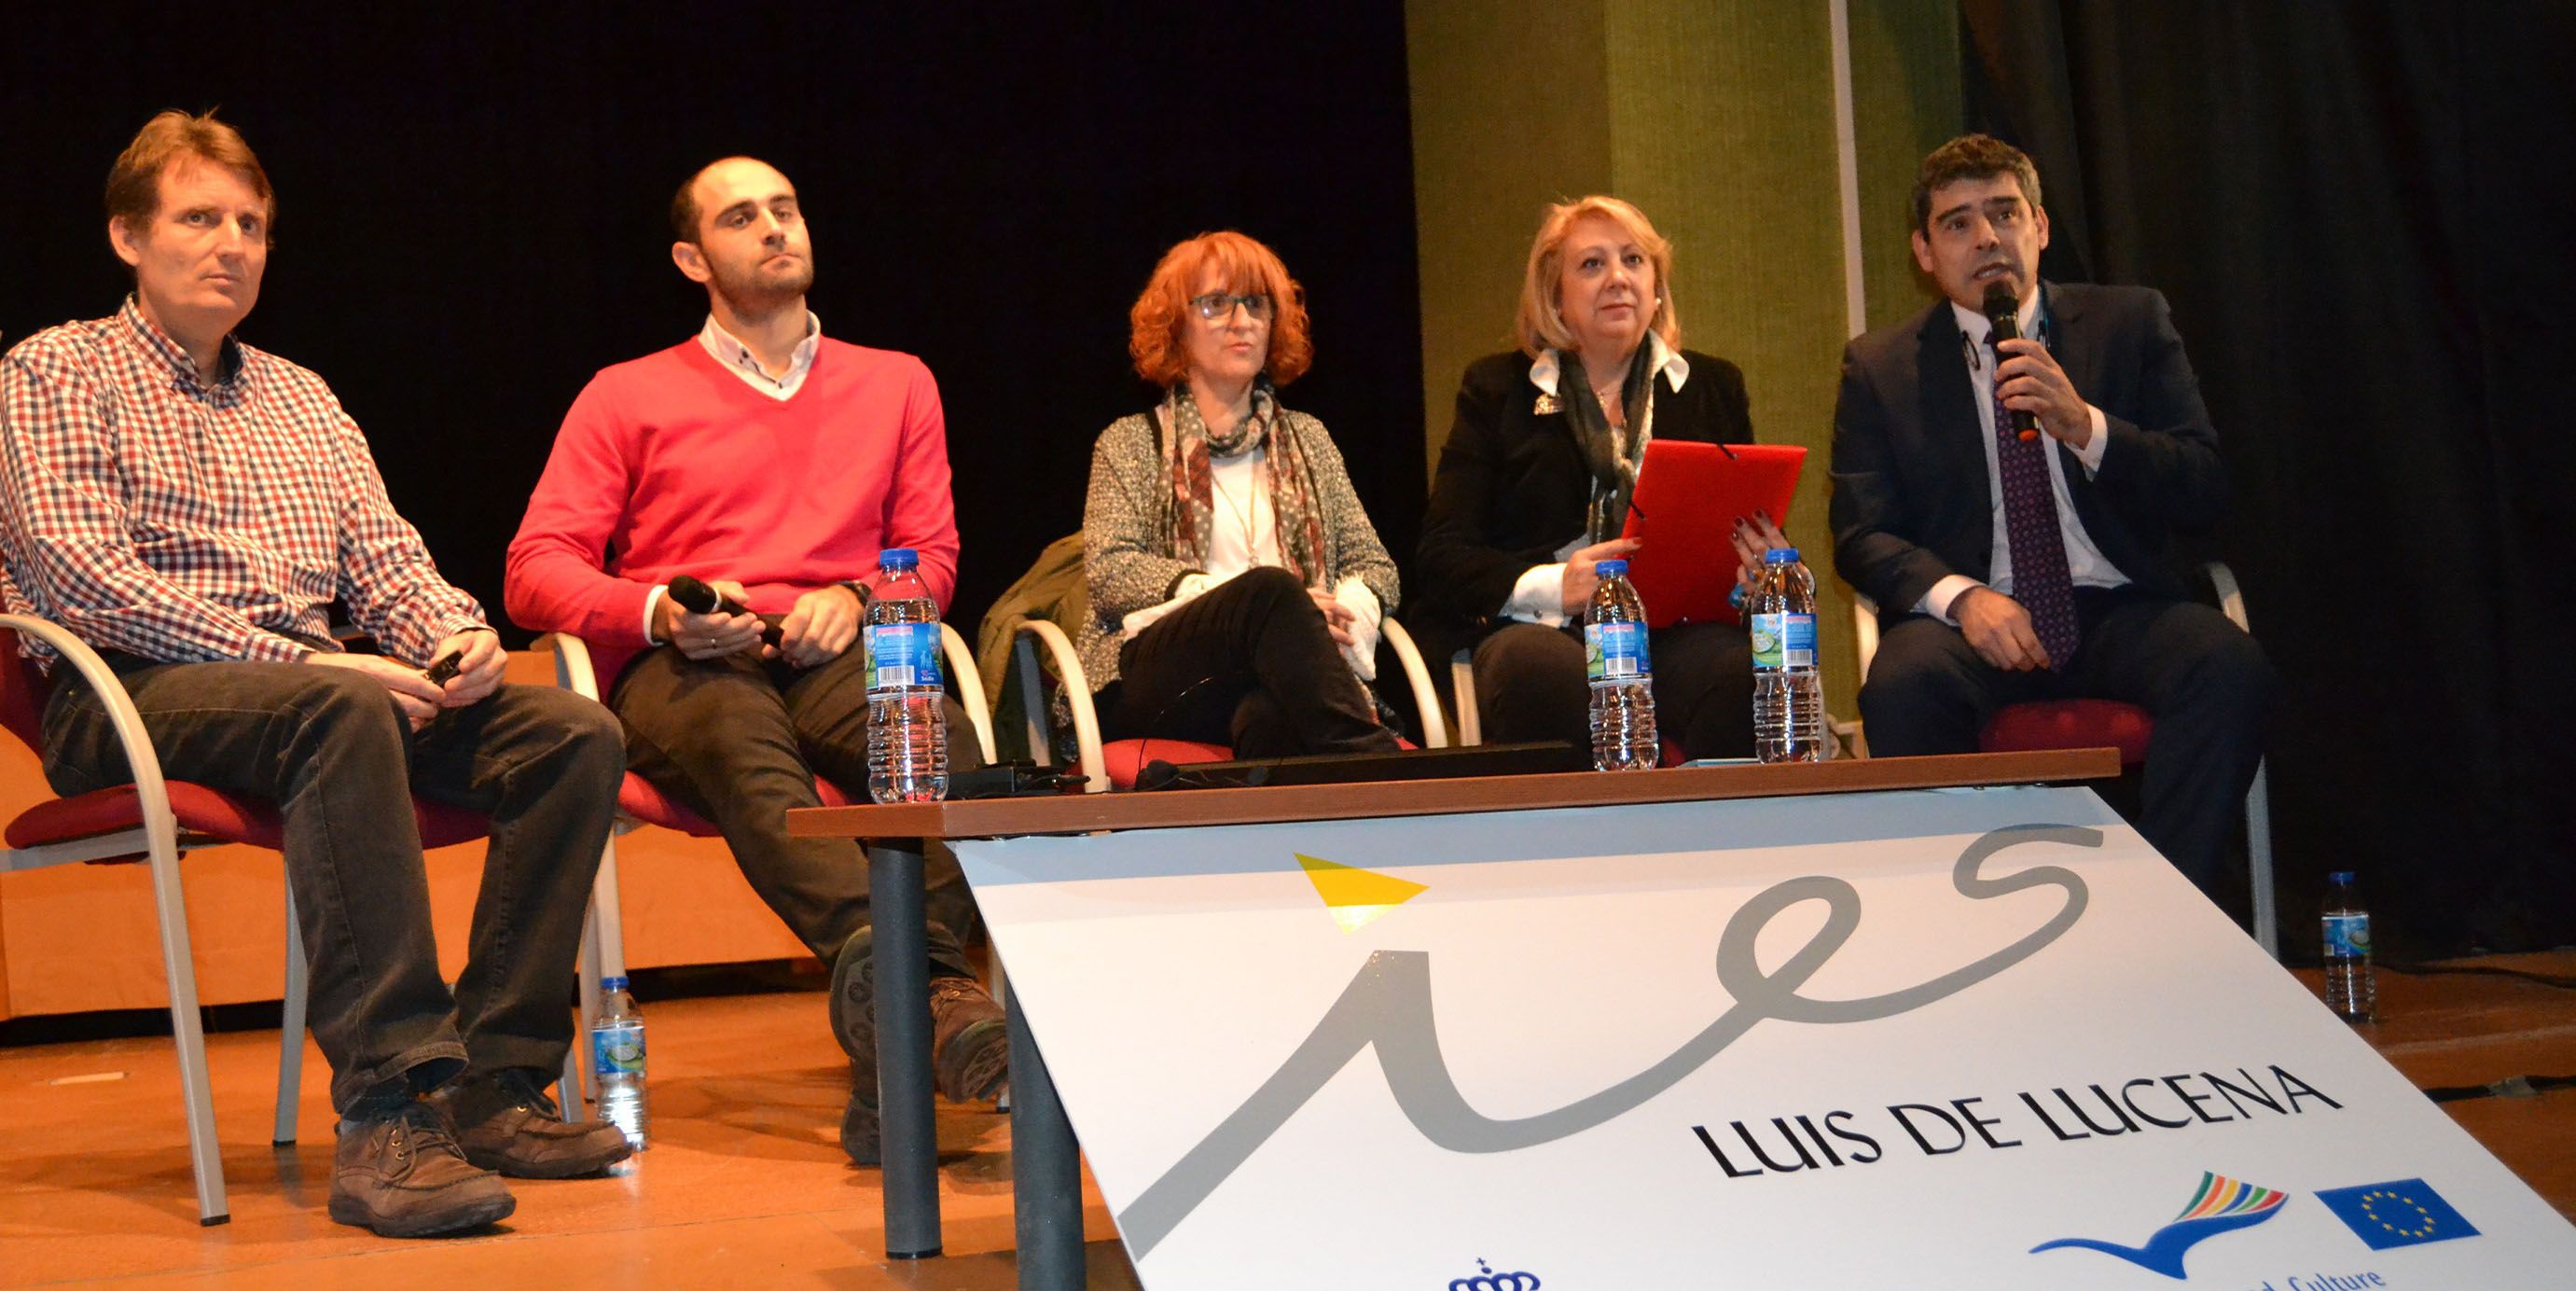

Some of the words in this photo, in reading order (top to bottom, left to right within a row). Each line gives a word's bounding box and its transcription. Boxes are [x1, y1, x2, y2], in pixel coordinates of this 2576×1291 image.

[1691, 1109, 1883, 1179] LUIS
[1887, 1096, 2024, 1157] DE
[2016, 1063, 2346, 1142] LUCENA
[2287, 1270, 2388, 1291] Culture
